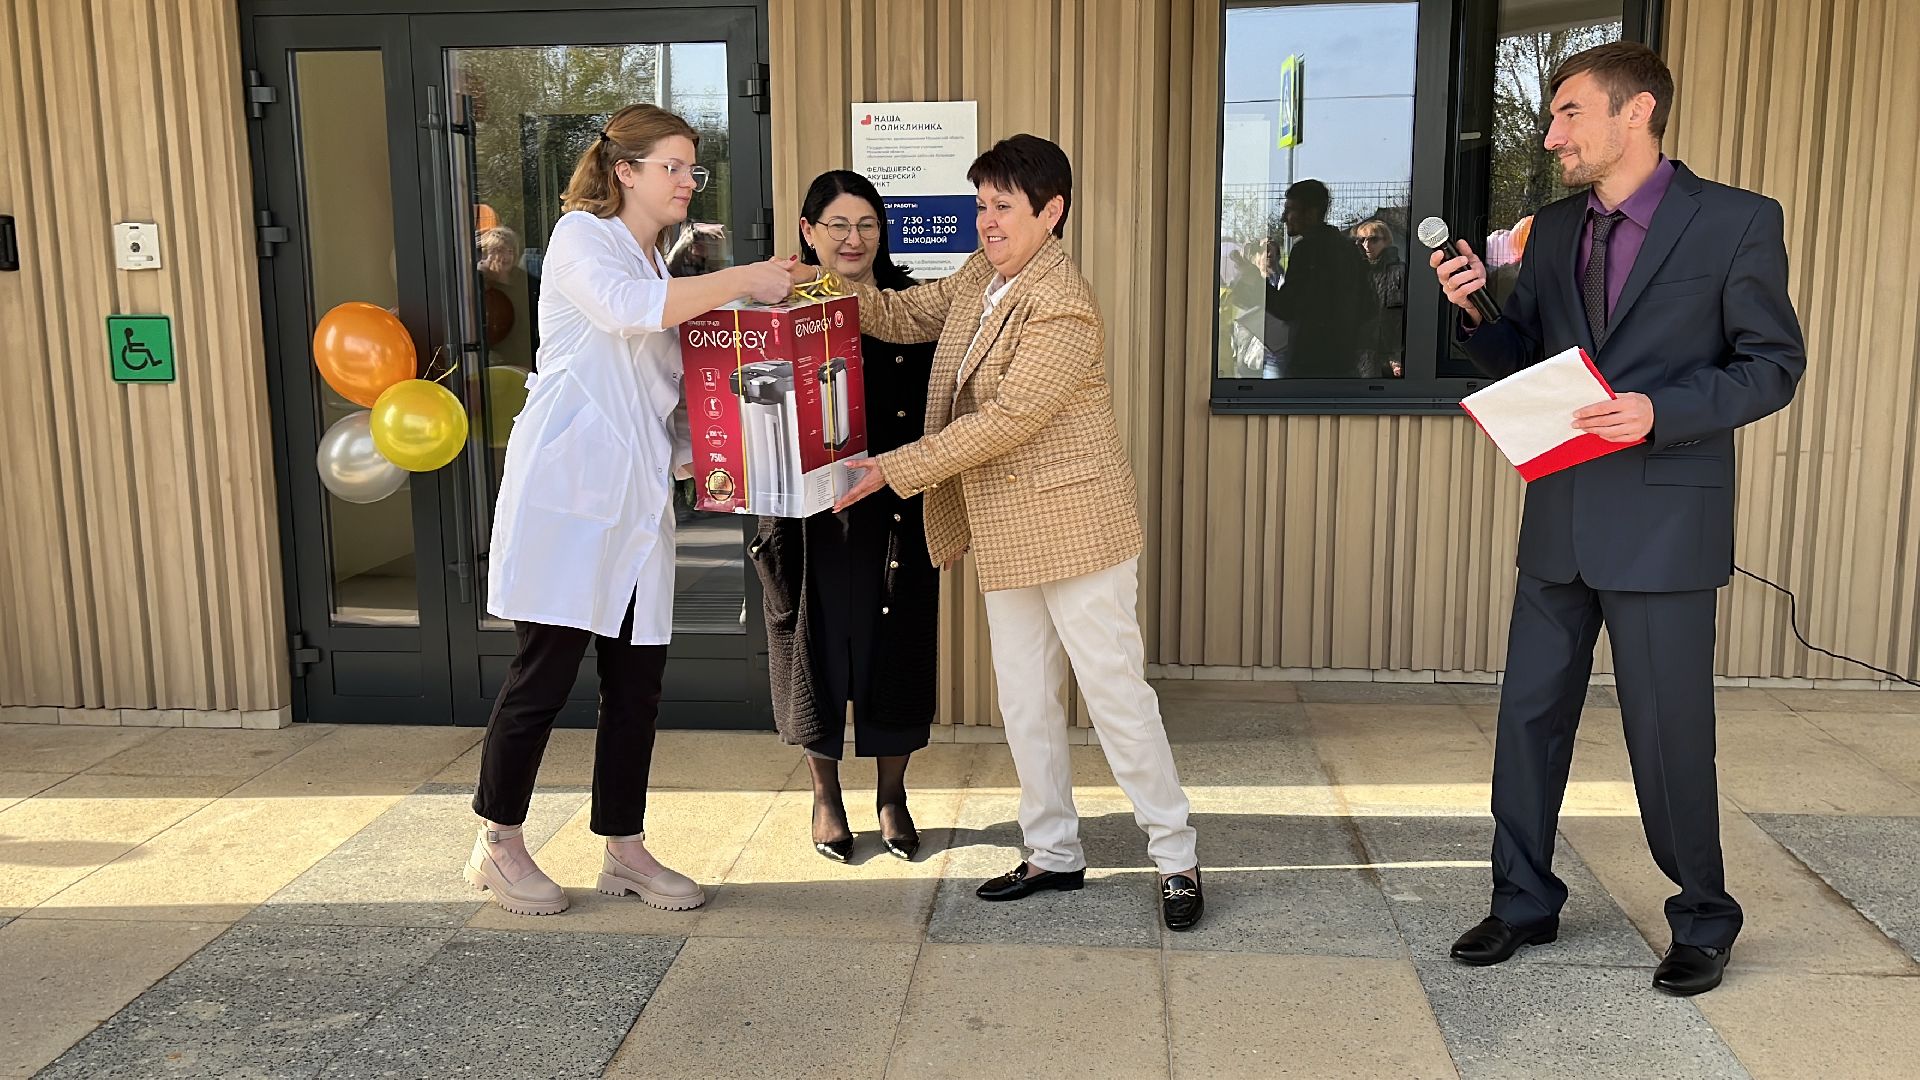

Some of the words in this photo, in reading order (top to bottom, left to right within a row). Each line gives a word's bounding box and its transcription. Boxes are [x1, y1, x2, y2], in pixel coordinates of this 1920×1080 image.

[874, 123, 942, 131] ПОЛИКЛИНИКА
[902, 216, 923, 225] 7:30
[932, 215, 958, 224] 13:00
[902, 225, 924, 235] 9:00
[932, 225, 957, 234] 12:00
[903, 235, 948, 244] ВЫХОДНОЙ
[706, 371, 712, 382] 5
